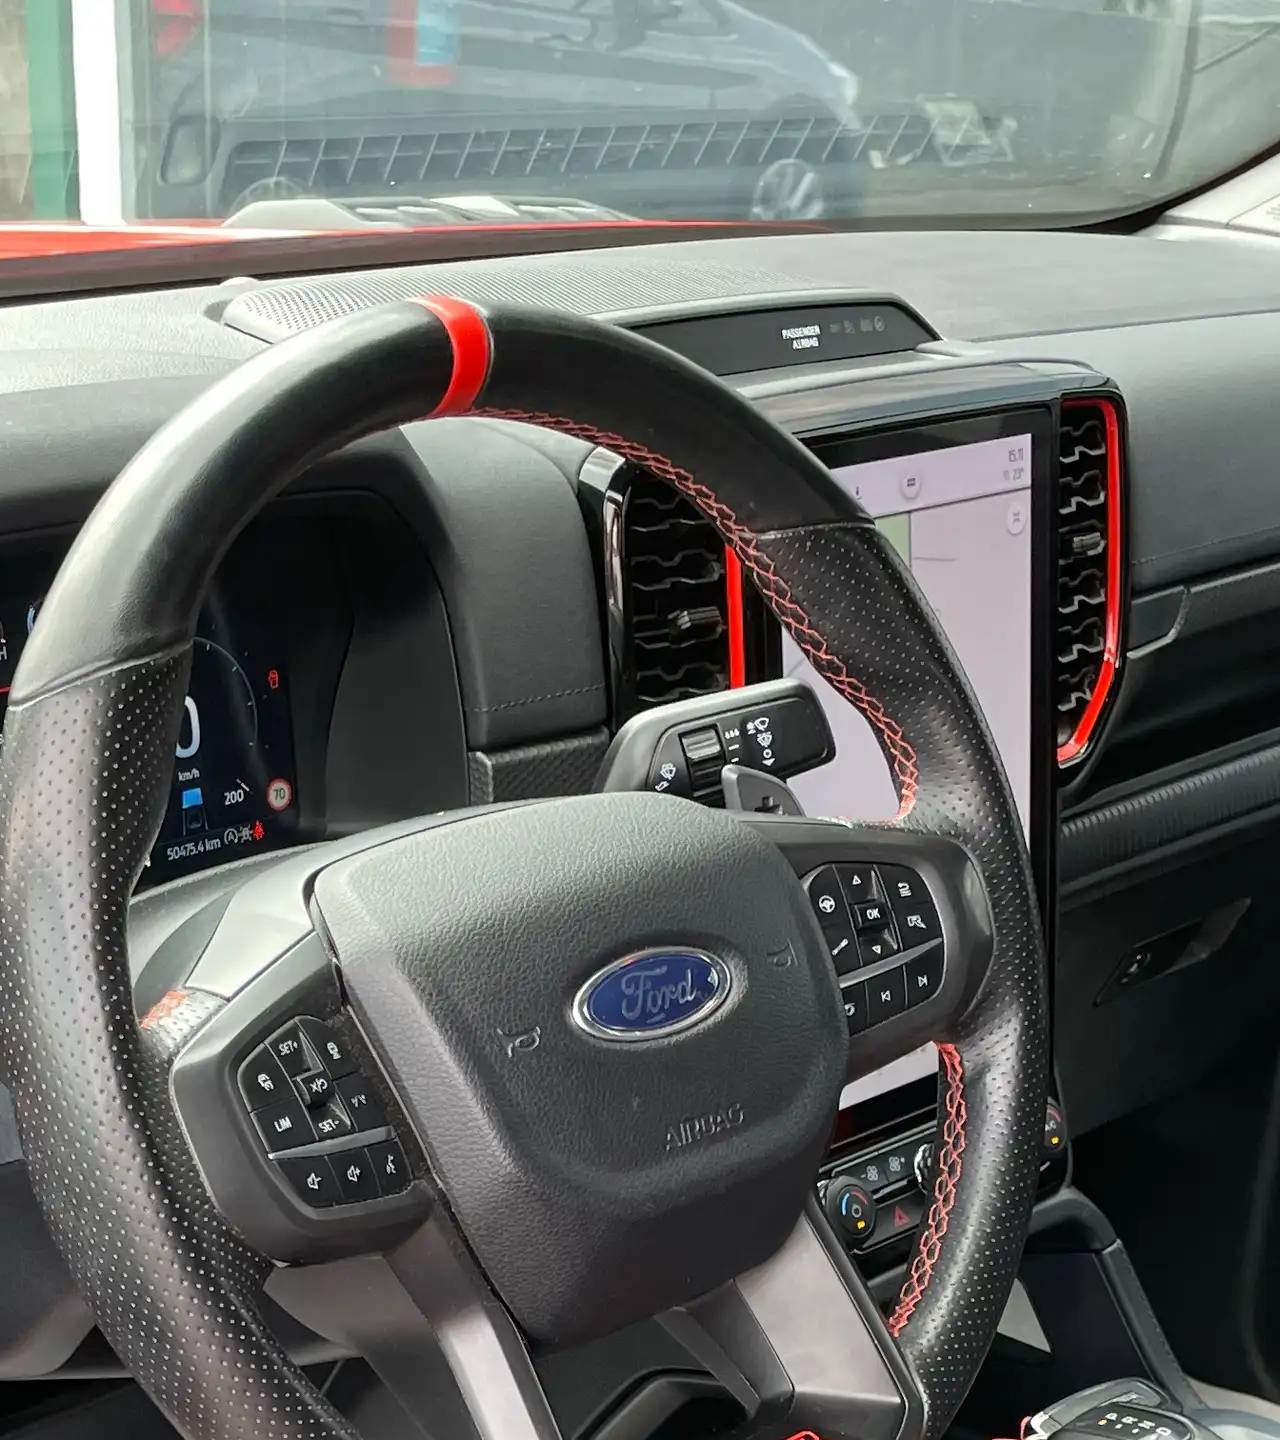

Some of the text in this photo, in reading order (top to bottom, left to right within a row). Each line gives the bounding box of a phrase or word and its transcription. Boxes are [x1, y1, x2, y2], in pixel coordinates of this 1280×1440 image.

[781, 325, 820, 339] PASSENGER
[792, 336, 819, 350] AIRBAG
[178, 767, 200, 782] km/h
[224, 789, 244, 806] 200
[273, 787, 286, 801] 70
[167, 837, 221, 861] 50475.4 km
[866, 908, 880, 920] OK
[621, 965, 698, 1021] Ford
[274, 1116, 292, 1132] LIM
[666, 1102, 745, 1152] AIRBAG
